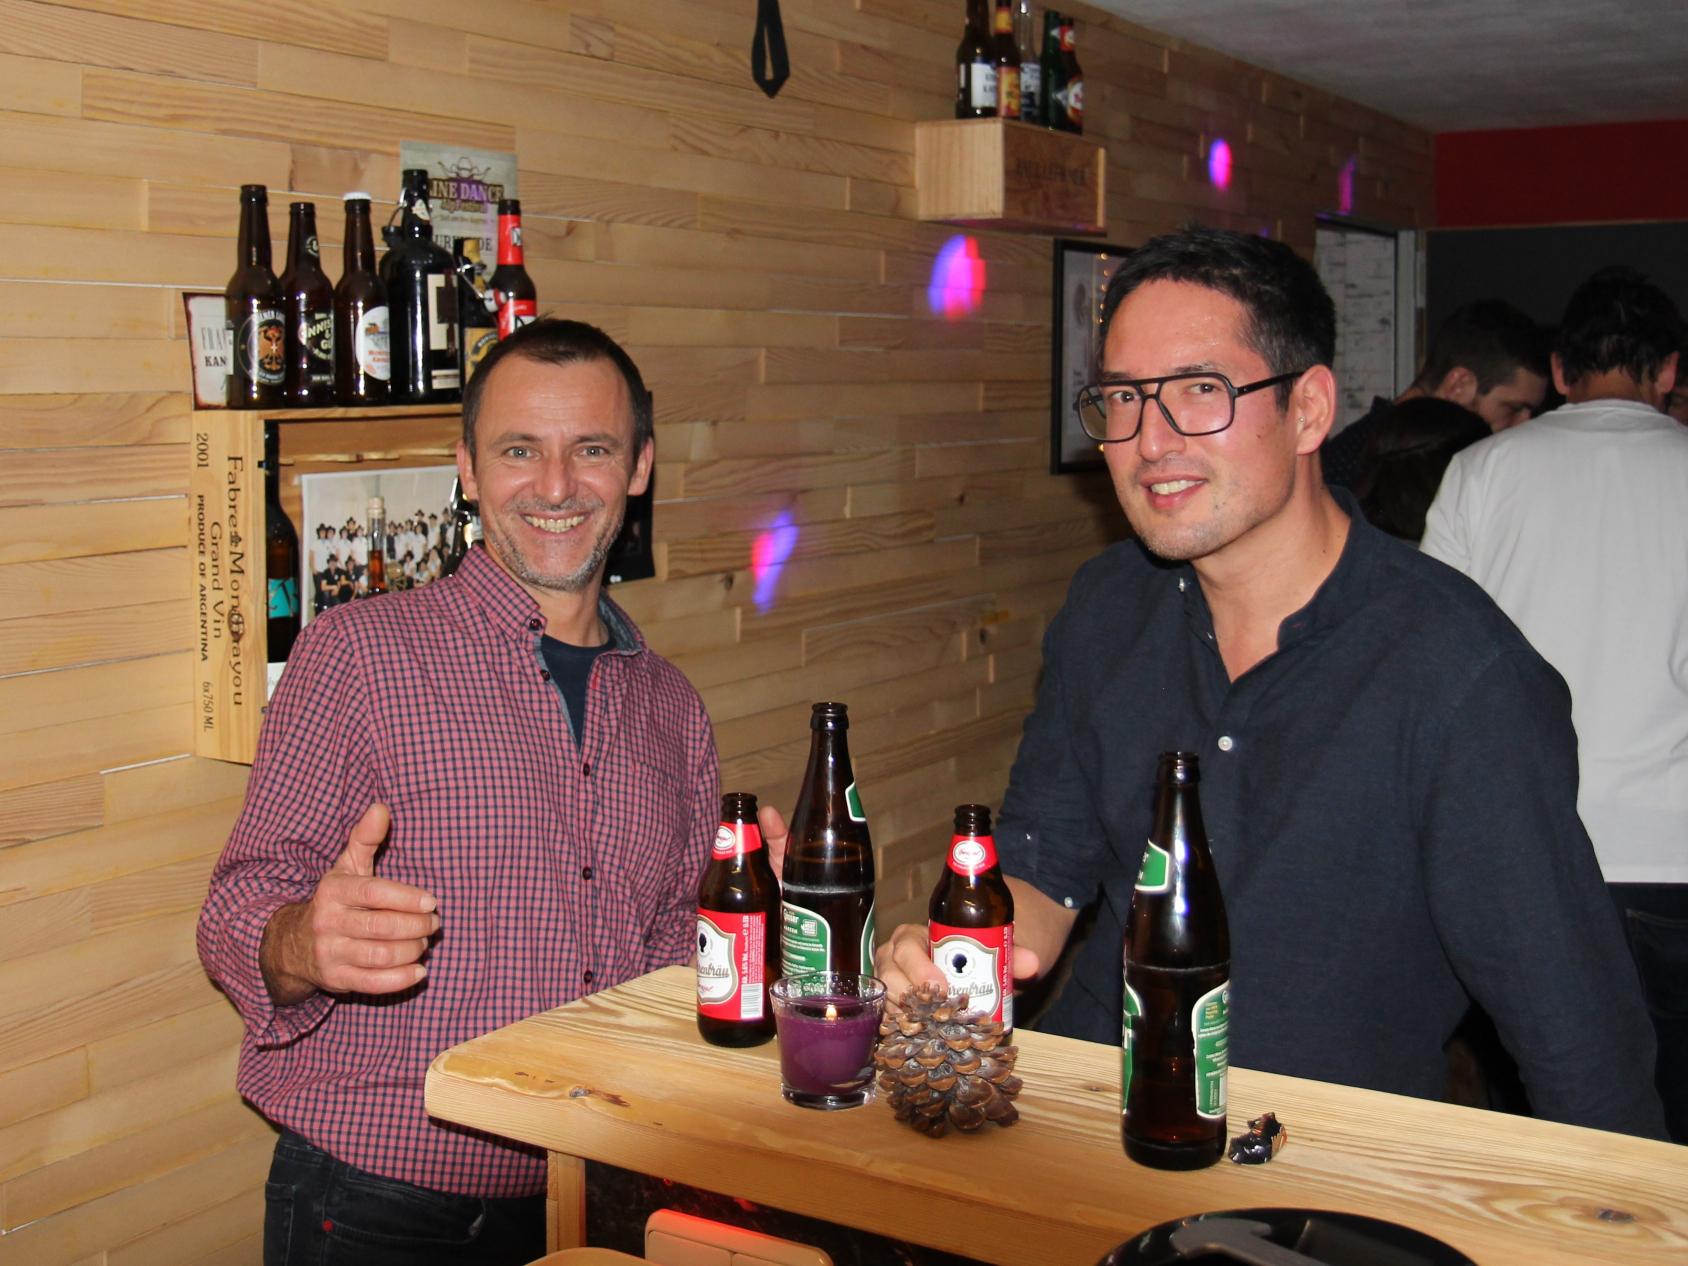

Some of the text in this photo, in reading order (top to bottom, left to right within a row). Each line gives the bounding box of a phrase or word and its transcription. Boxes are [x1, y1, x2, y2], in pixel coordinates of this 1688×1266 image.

[428, 181, 457, 199] INE
[196, 433, 208, 467] 2001
[197, 495, 208, 662] PRODUCE OF ARGENTINA
[211, 521, 224, 638] Grand Vin
[228, 456, 245, 706] Fabre Monmayou
[202, 681, 214, 732] 6x750 ML
